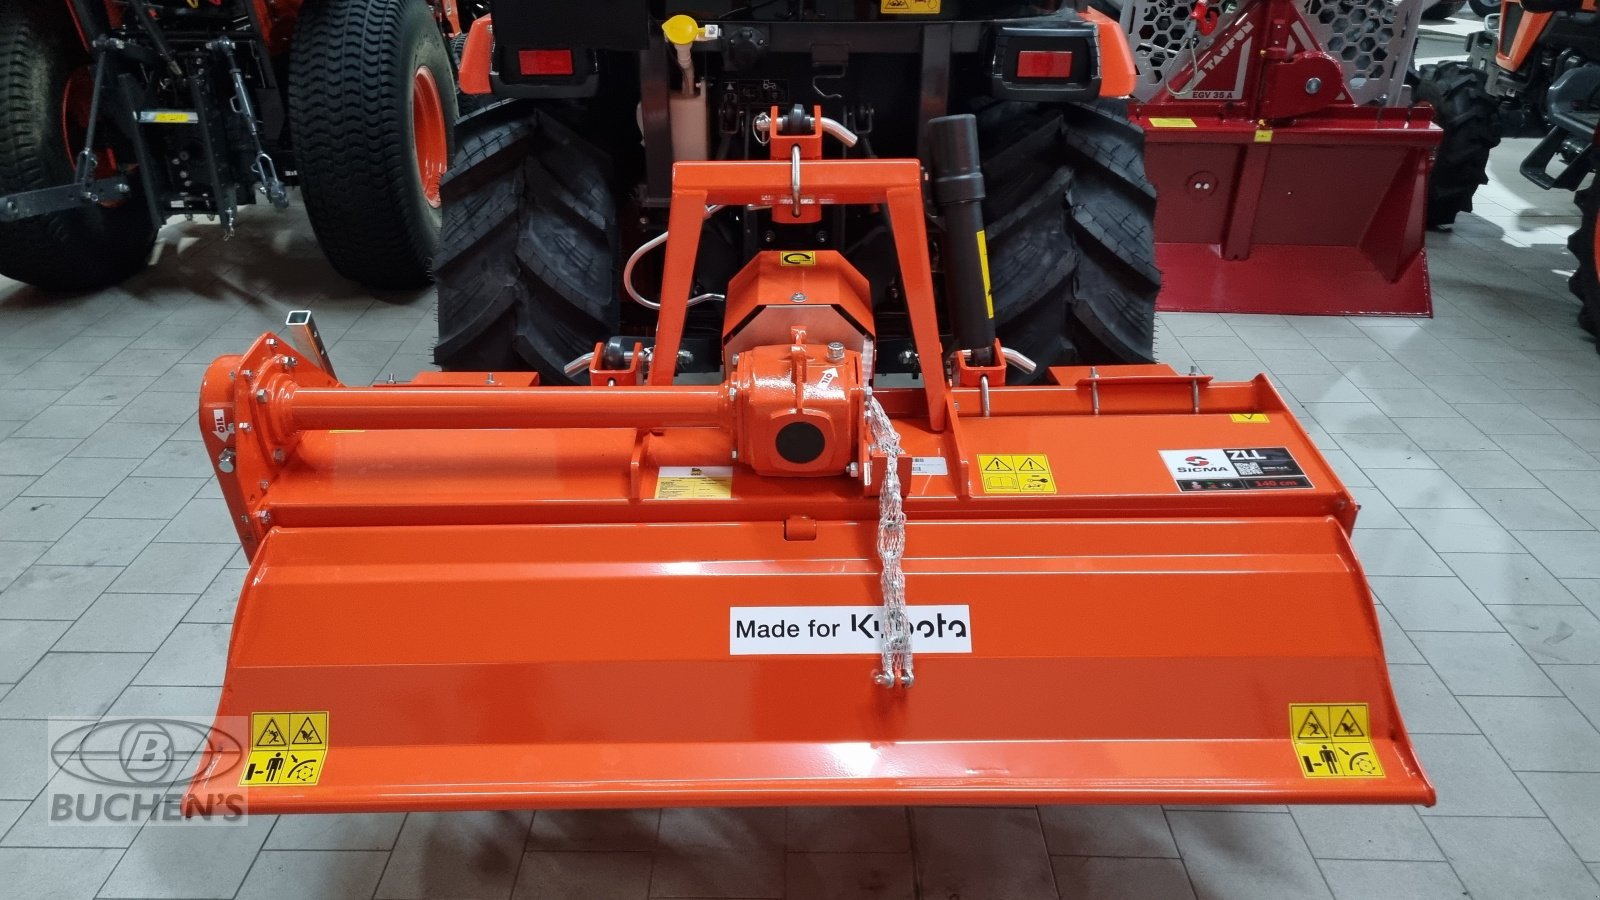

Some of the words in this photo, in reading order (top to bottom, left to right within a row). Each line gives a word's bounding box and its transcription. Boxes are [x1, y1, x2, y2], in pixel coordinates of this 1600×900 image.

[1203, 21, 1254, 70] TAJFUN
[1192, 91, 1211, 99] EGV
[1213, 91, 1225, 99] 35
[1227, 91, 1233, 99] A
[821, 373, 833, 384] OIL
[216, 417, 225, 433] OIL
[1226, 449, 1267, 460] ZLL
[736, 619, 800, 638] Made
[807, 619, 841, 638] for
[851, 613, 967, 638] Kota
